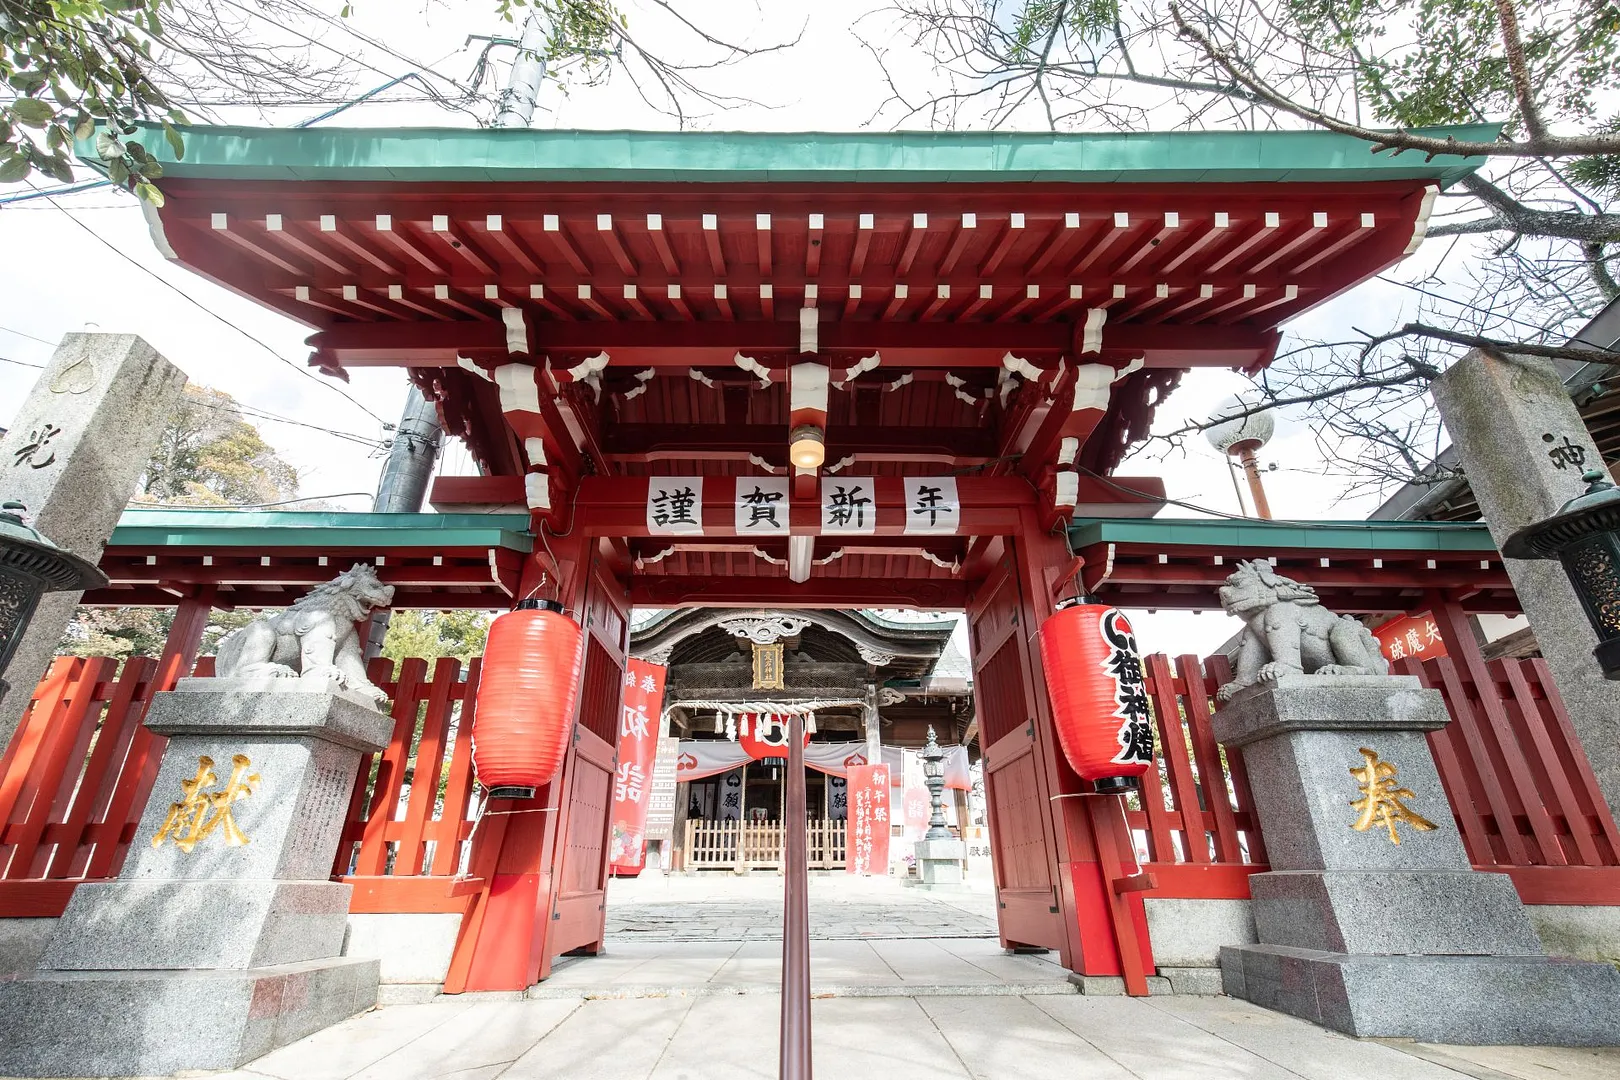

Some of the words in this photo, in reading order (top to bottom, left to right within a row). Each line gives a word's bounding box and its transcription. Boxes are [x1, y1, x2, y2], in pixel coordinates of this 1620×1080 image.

[651, 485, 952, 529] 謹賀新年
[1389, 620, 1443, 660] 破魔矢
[151, 753, 261, 854] 献
[871, 769, 888, 823] 初午祭
[1349, 746, 1441, 846] 奉
